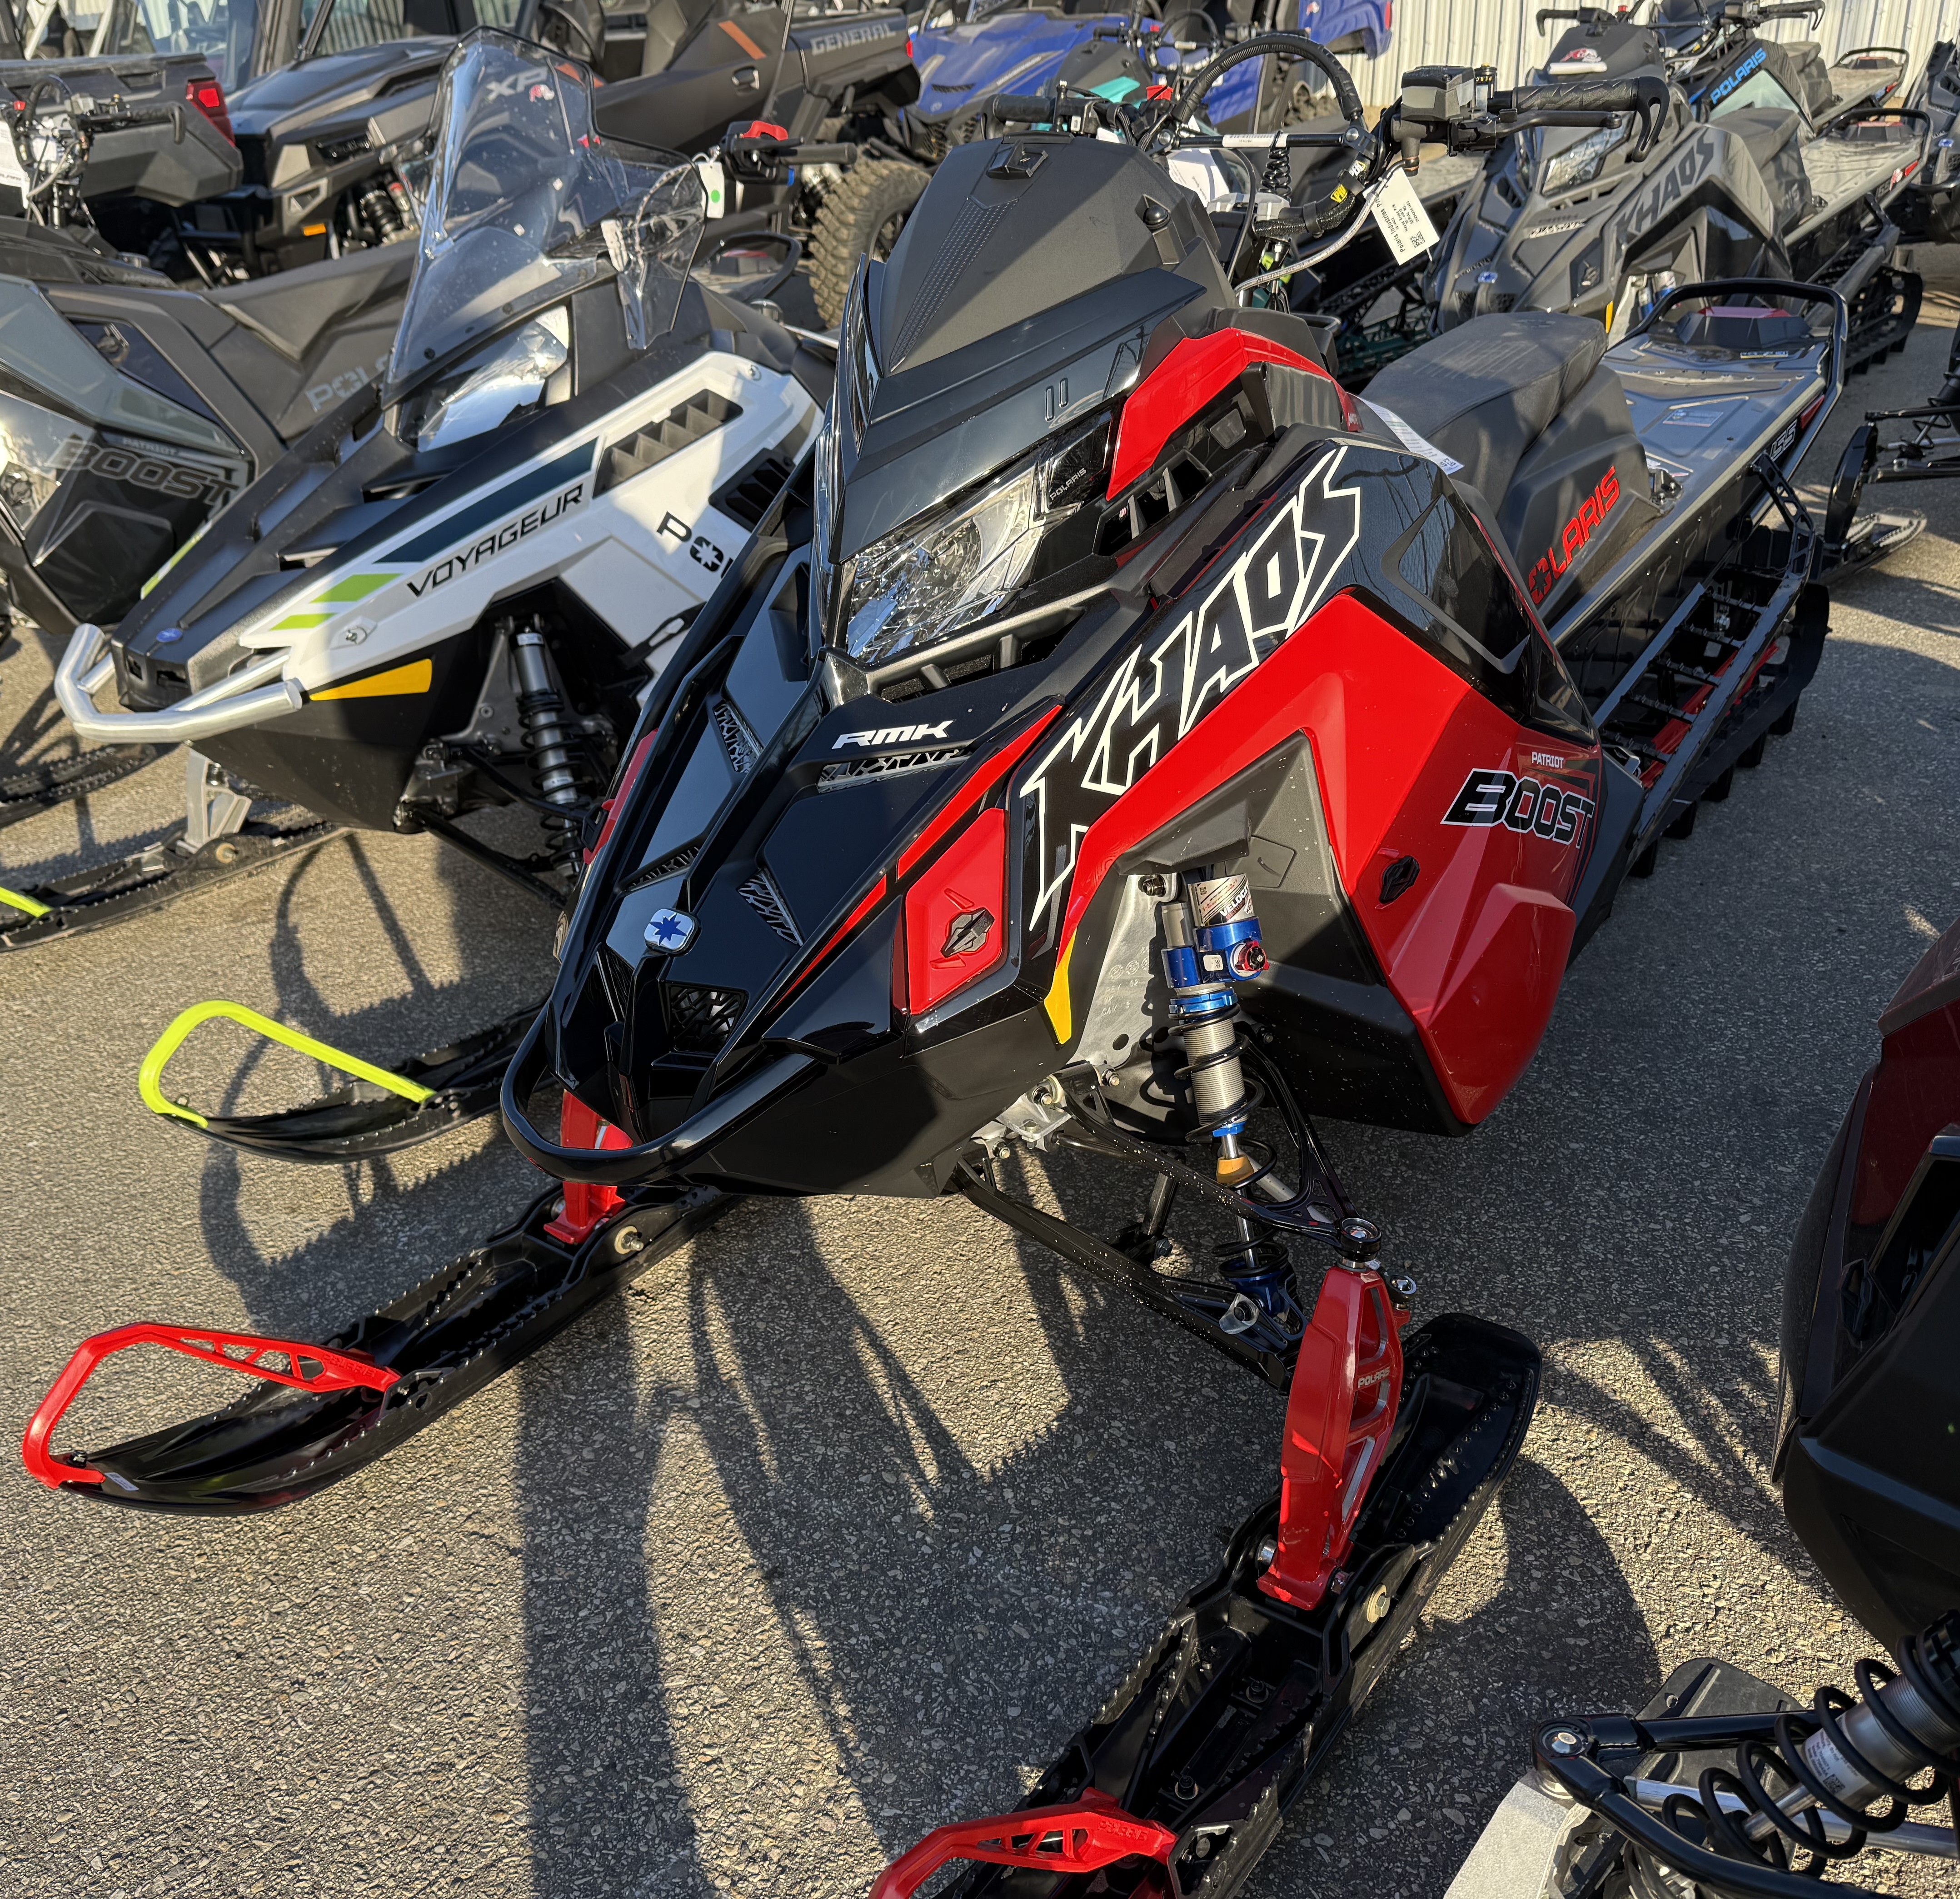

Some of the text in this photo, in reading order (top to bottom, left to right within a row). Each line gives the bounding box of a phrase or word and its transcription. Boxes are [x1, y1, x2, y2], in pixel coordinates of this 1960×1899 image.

[810, 23, 896, 56] GENERAL
[1710, 47, 1767, 105] POLARIS
[1380, 208, 1396, 234] Industries
[1394, 234, 1406, 253] Polaris
[122, 437, 178, 455] PATRIOT
[44, 439, 240, 506] BOOST
[1049, 468, 1087, 500] POLARIS
[407, 483, 584, 598] VOYAGEUR
[1528, 465, 1620, 604] OLARIS
[1019, 445, 1361, 932] KHAOS
[831, 720, 953, 750] RMK
[1531, 751, 1564, 769] PATRIOT
[1440, 768, 1596, 849] BOOST
[1358, 1366, 1391, 1389] POLARIS
